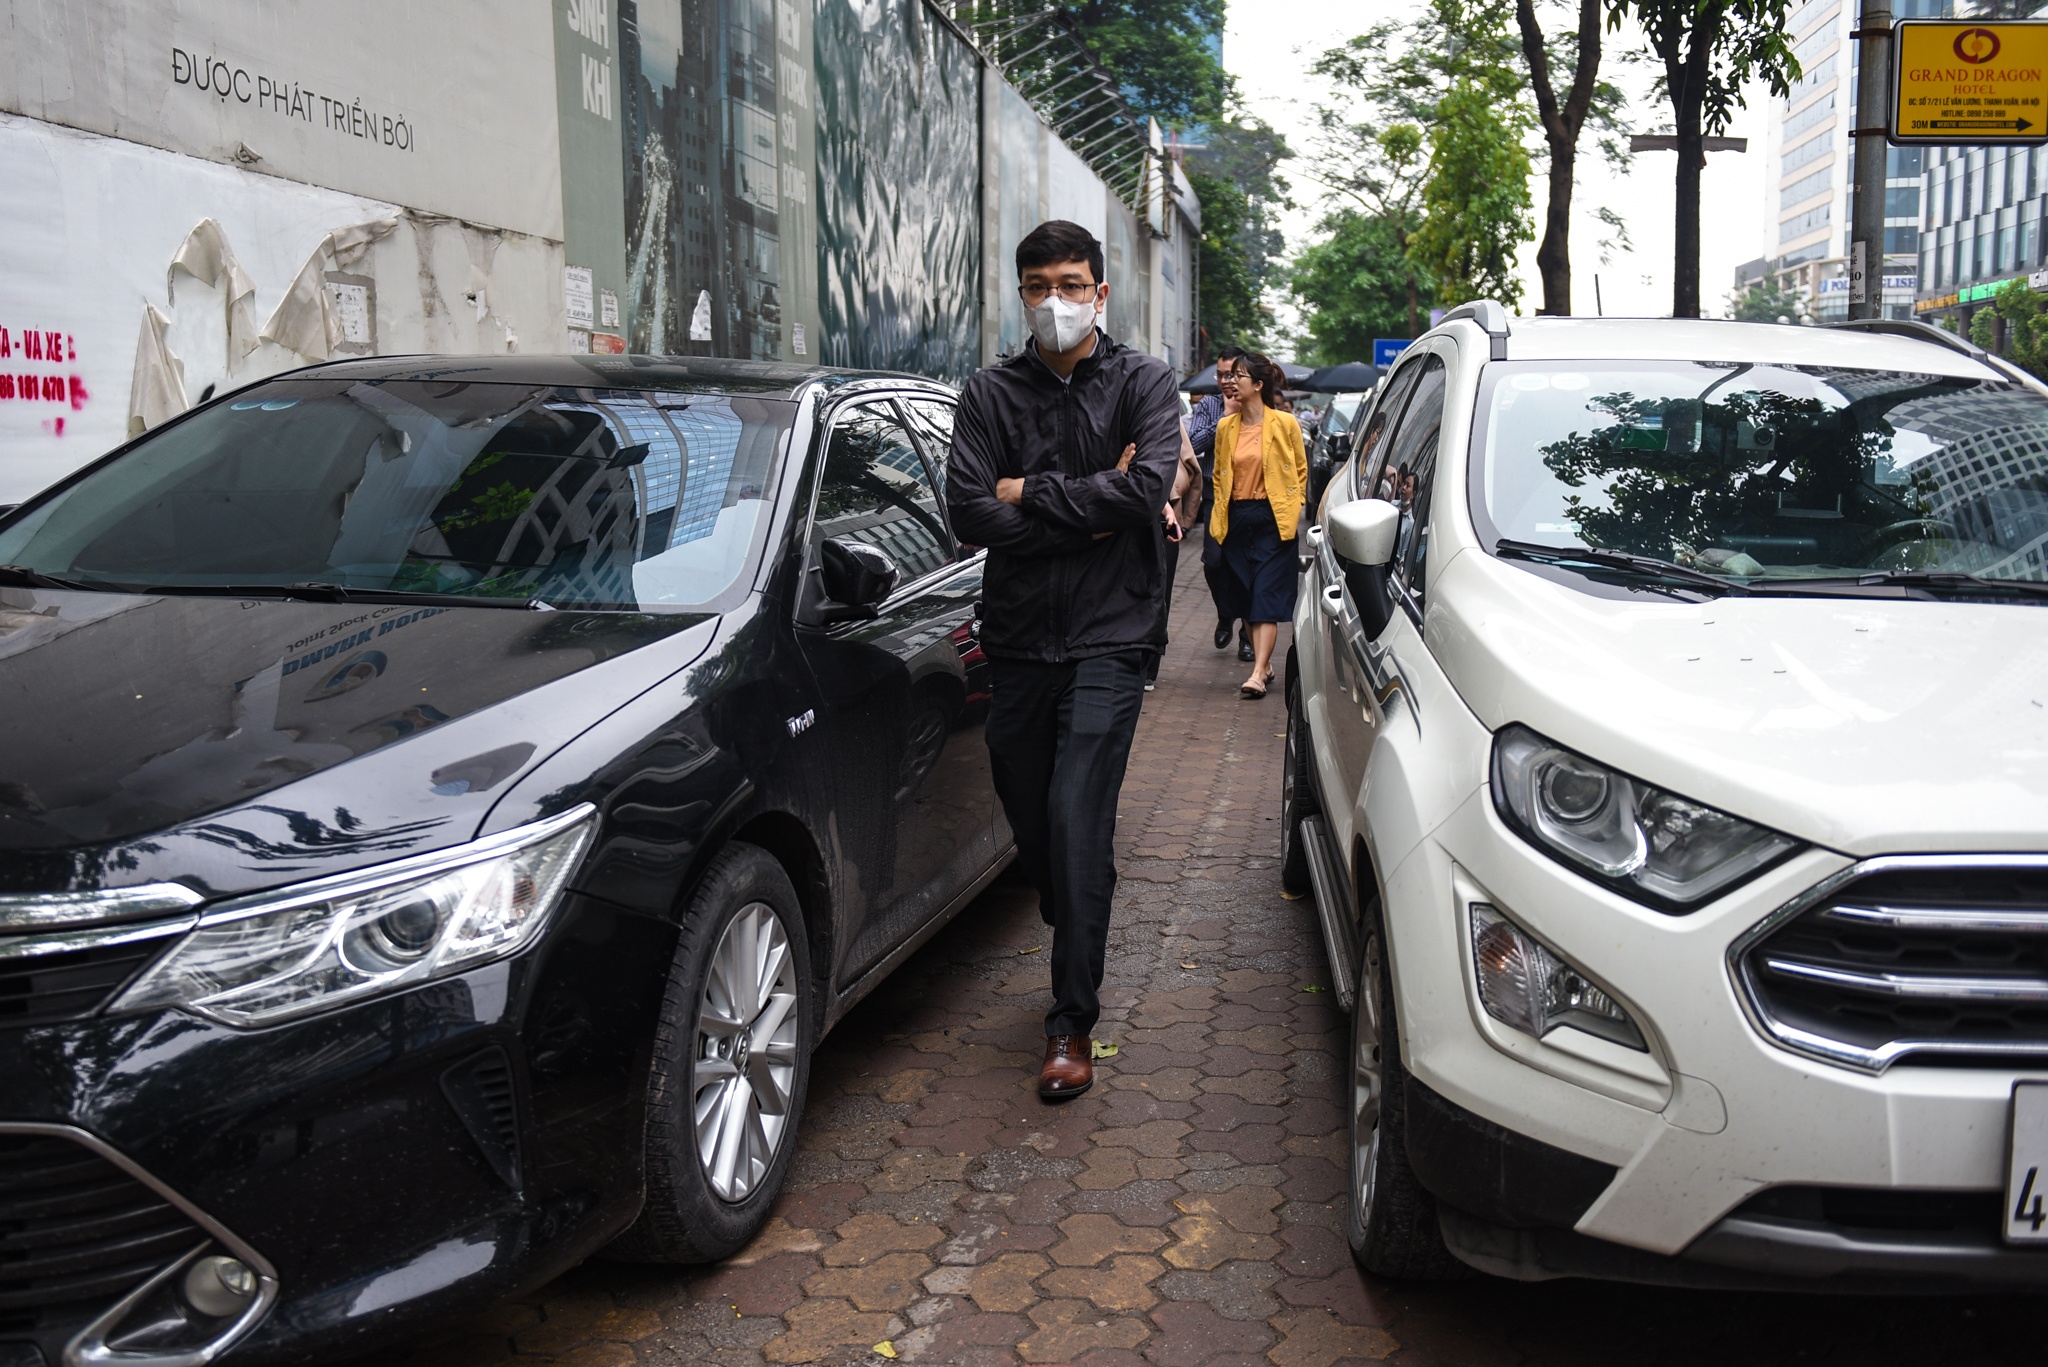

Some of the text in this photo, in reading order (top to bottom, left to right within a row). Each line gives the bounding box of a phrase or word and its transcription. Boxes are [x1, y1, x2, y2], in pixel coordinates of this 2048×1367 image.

[581, 53, 612, 121] KHÍ
[779, 53, 807, 109] YORK
[1909, 69, 2041, 82] GRAND DRAGON
[172, 48, 414, 152] ĐƯỢC PHÁT TRIỂN BỞI
[1928, 98, 1942, 106] 7/21
[1953, 84, 1996, 94] HOTEL
[1911, 120, 1928, 129] 30M
[1941, 110, 1965, 118] HOTLINE:
[782, 110, 797, 151] SÔI
[1831, 280, 1849, 291] POL
[45, 331, 63, 363] XE
[42, 376, 65, 402] 470
[2014, 1166, 2047, 1233] 4
